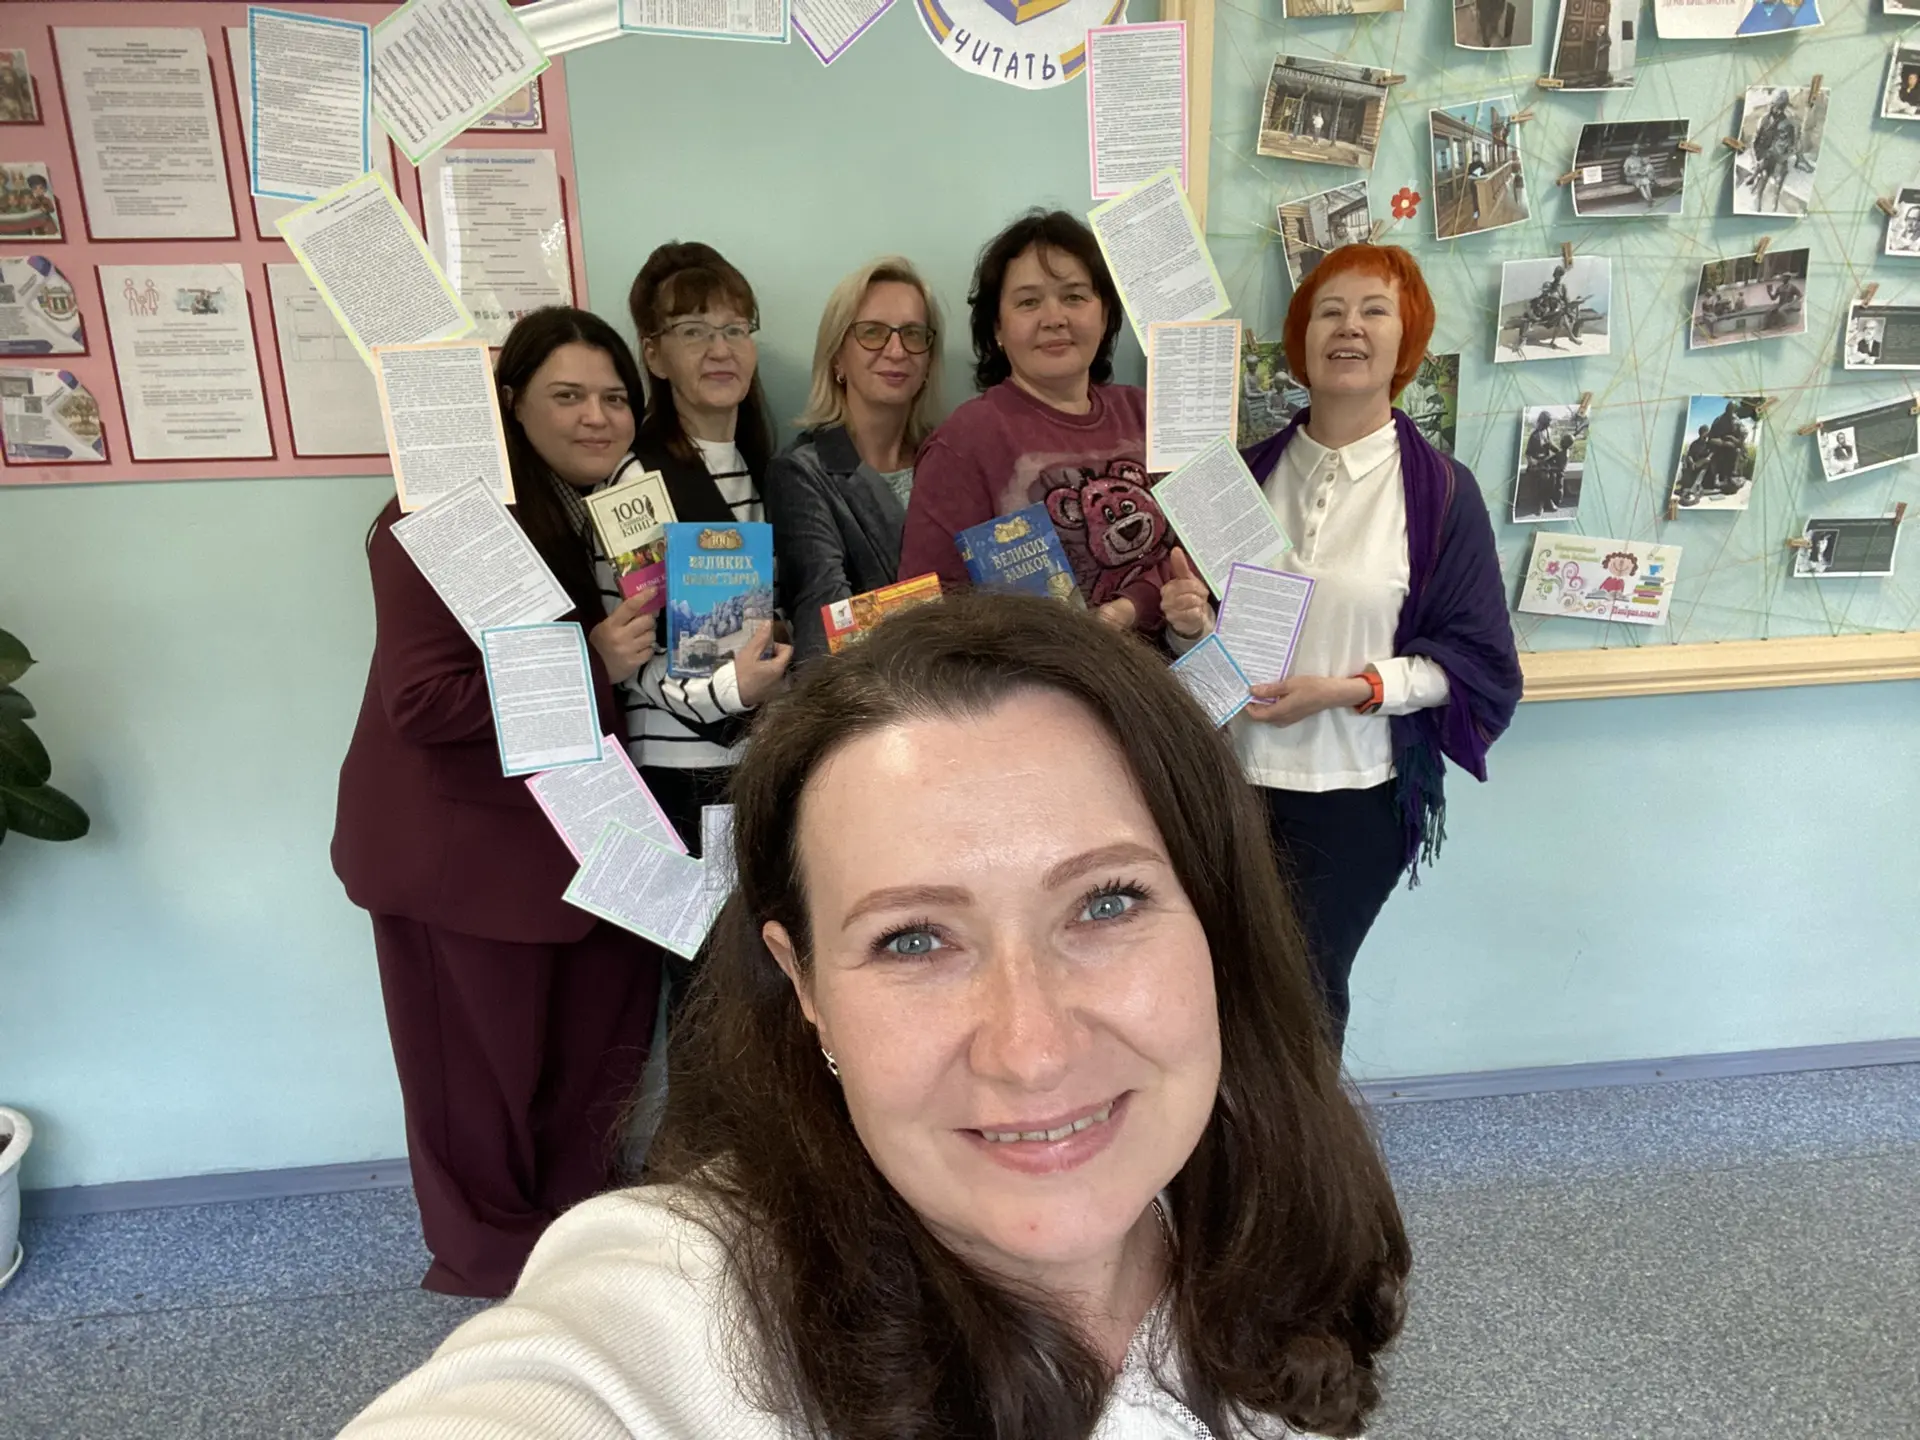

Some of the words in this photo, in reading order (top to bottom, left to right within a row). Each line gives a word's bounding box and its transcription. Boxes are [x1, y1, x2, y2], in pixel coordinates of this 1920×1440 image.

[955, 29, 1056, 80] ЧИТАТЬ
[611, 498, 645, 523] 100
[711, 535, 730, 546] 100
[992, 537, 1050, 569] ВЕЛИКИХ
[688, 555, 754, 569] ВЕЛИКИХ
[1003, 554, 1050, 583] ЗАМКОВ
